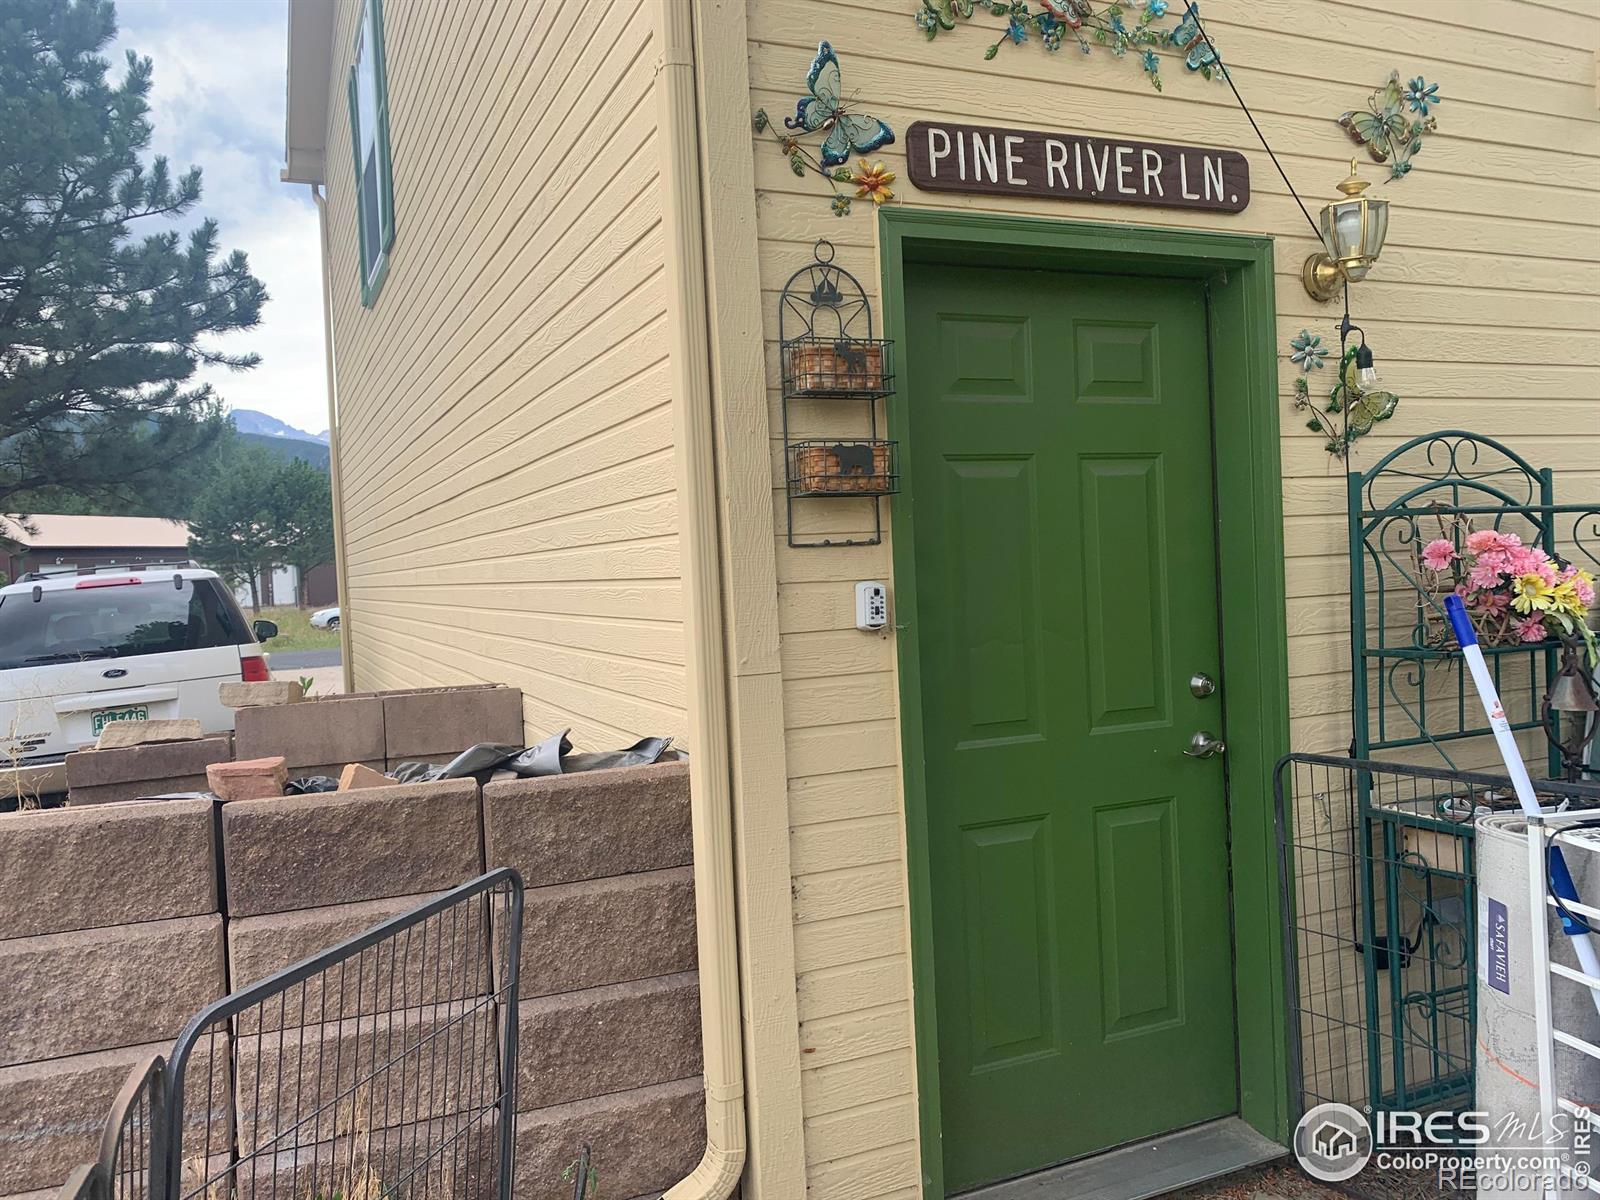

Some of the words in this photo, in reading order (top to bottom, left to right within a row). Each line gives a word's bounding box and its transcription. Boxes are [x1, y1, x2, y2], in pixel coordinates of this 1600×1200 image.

[928, 128, 1028, 186] PINE
[1045, 138, 1164, 197] RIVER
[1180, 152, 1239, 203] LN.
[1495, 922, 1506, 983] SAFAVIEH
